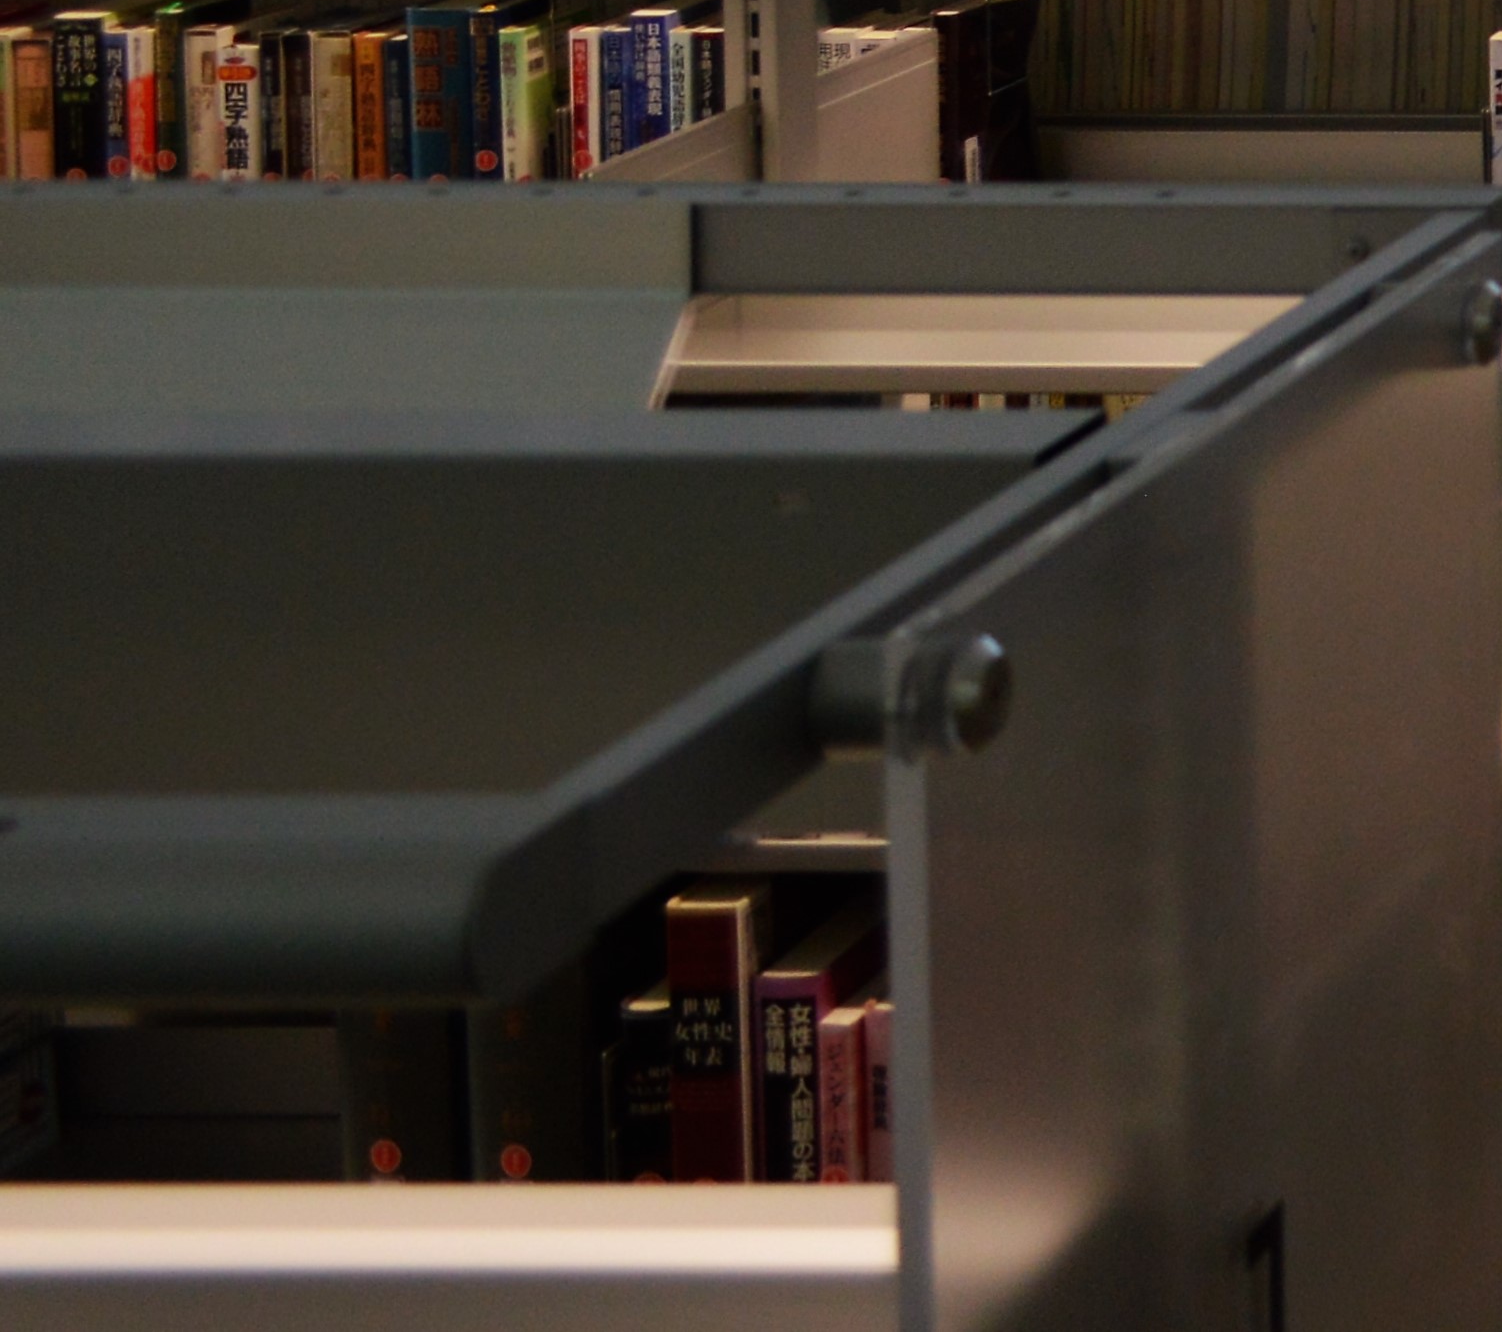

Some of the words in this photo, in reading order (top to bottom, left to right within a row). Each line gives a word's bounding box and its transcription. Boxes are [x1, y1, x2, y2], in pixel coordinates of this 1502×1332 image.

[683, 997, 721, 1017] 世界
[675, 1022, 733, 1042] 女性史
[765, 1004, 786, 1075] 全情報
[685, 1047, 722, 1067] 年表
[790, 1004, 814, 1182] 女性・婦人問題の本
